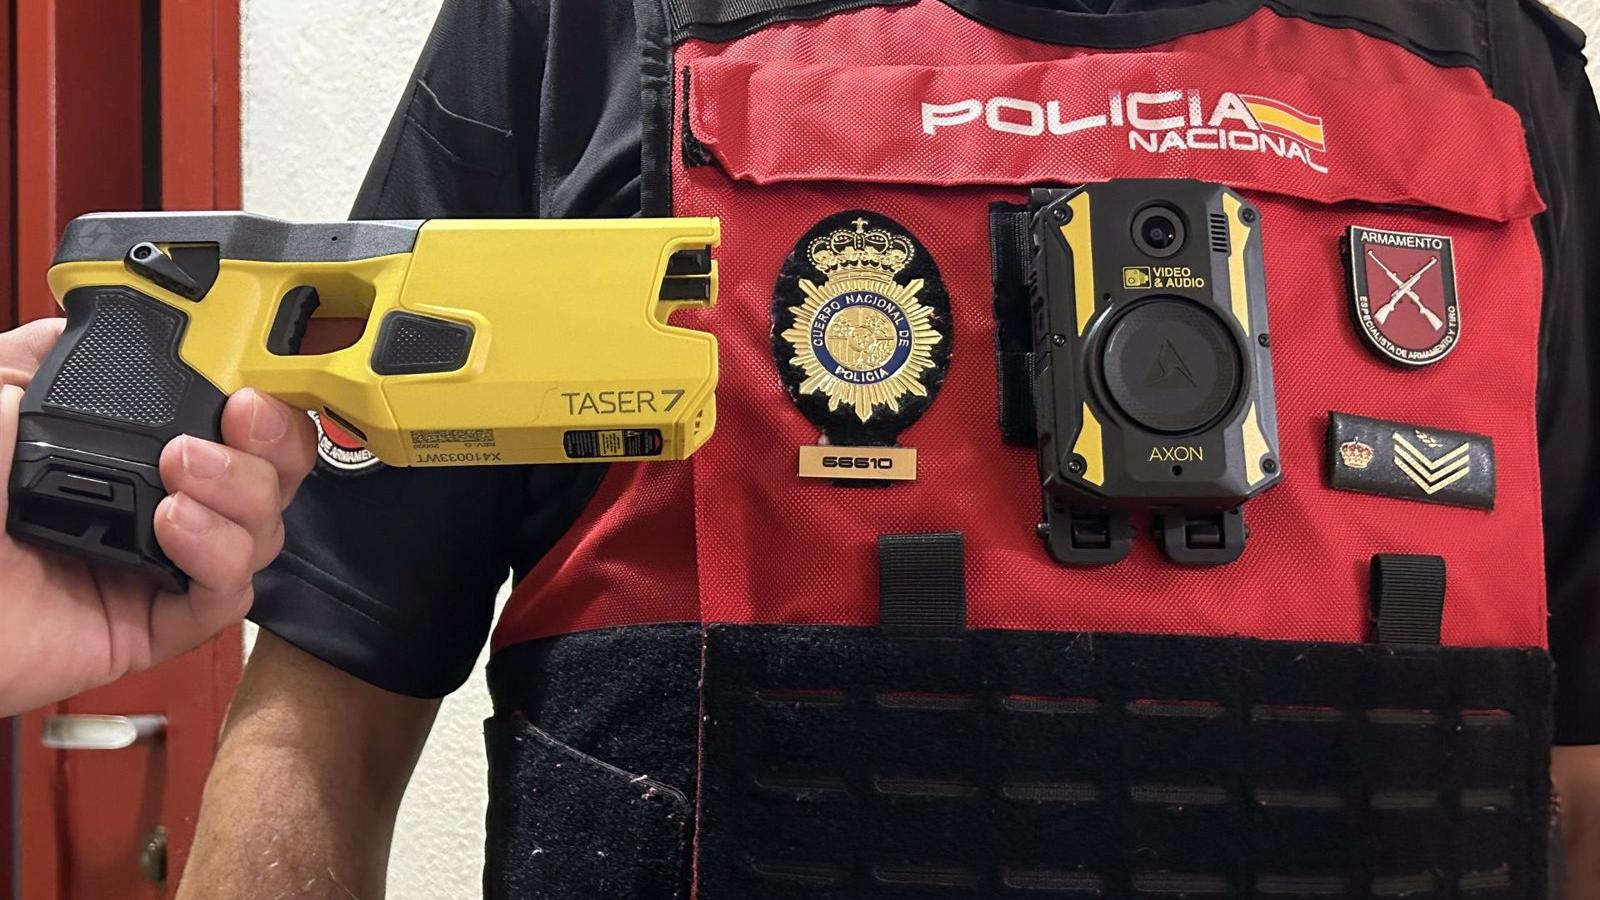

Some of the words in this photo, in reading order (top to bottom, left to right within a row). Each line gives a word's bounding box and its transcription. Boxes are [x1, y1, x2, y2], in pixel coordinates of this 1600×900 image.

[921, 88, 1260, 136] POLICIA
[1128, 127, 1329, 174] NACIONAL
[1360, 231, 1443, 250] ARMAMENTO
[1153, 267, 1191, 277] VIDEO
[1154, 278, 1163, 288] &
[1166, 277, 1205, 288] AUDIO
[812, 301, 841, 347] CUERPO
[845, 294, 905, 326] NACIONAL
[898, 329, 910, 347] DE
[1359, 295, 1396, 355] ESPECIALISTA
[1395, 347, 1408, 358] DE
[1407, 335, 1453, 360] ARMAMENTO
[1447, 305, 1457, 329] TIRO
[834, 365, 890, 383] POLICIA
[561, 390, 657, 416] TASER
[661, 389, 686, 412] 7
[416, 452, 502, 463] X410033WT
[1148, 446, 1204, 461] AXON
[822, 456, 893, 470] 66610
